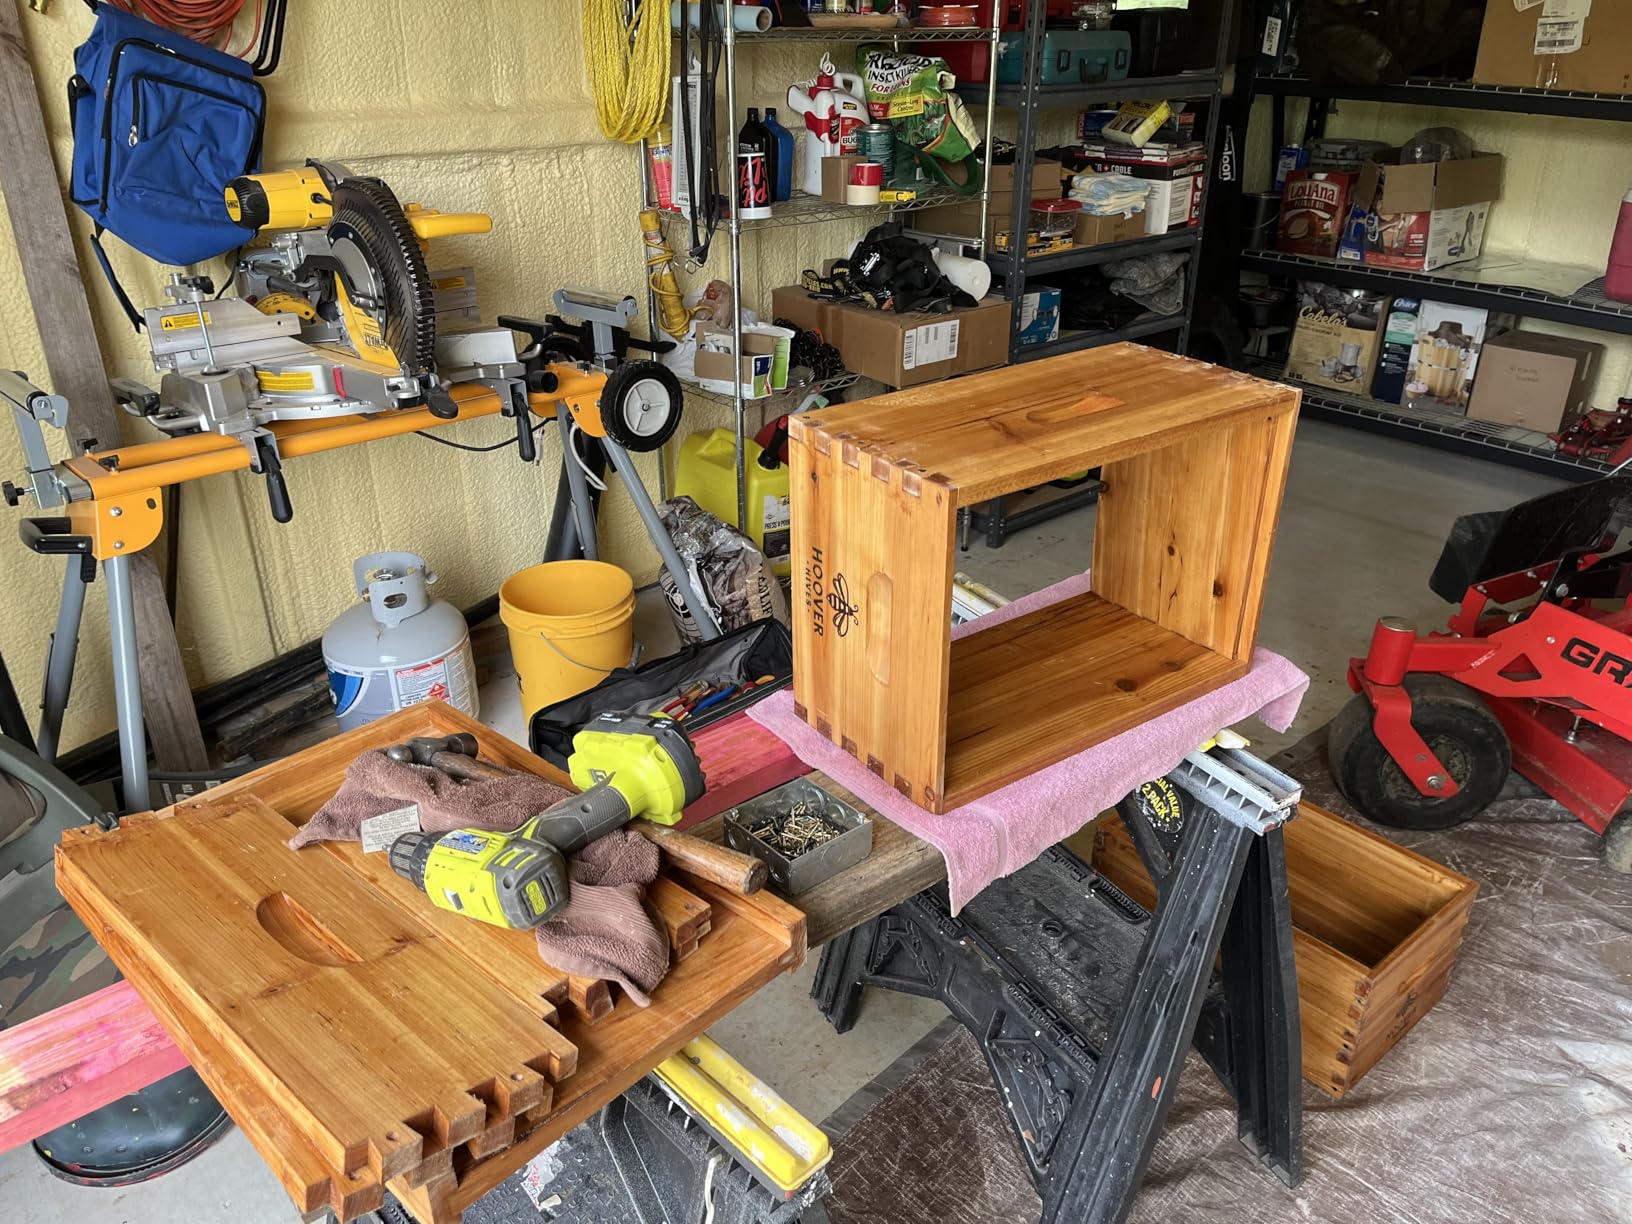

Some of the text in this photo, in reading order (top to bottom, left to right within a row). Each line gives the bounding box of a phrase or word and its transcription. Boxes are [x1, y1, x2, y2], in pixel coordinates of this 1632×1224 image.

[870, 83, 889, 93] FOR
[1110, 164, 1133, 175] CABLE
[1290, 183, 1335, 203] LouAna
[1299, 305, 1348, 327] Cabela's
[811, 544, 824, 637] HOOVER
[1560, 636, 1632, 688] GR
[1166, 789, 1180, 818] VALUE
